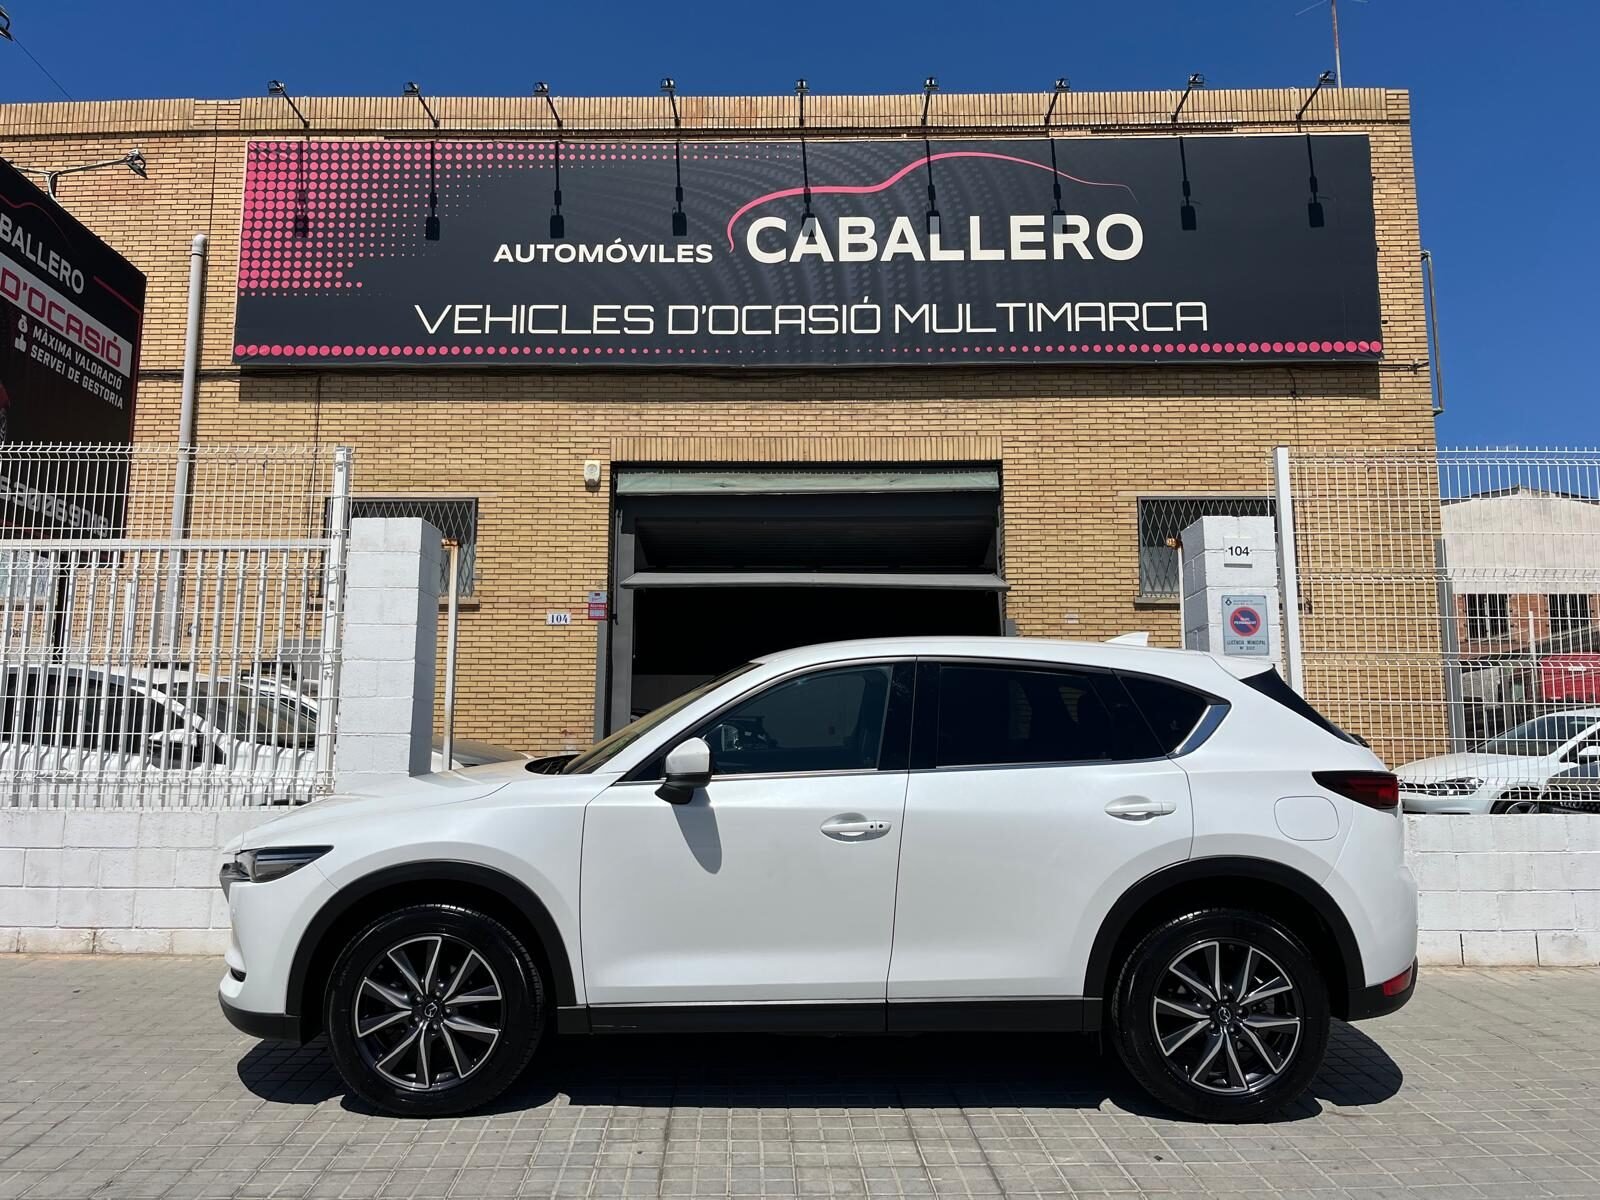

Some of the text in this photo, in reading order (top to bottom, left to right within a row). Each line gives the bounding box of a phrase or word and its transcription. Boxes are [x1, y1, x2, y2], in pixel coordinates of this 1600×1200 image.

[493, 213, 1144, 264] AUTOMÓVILES CABALLERO
[0, 267, 121, 368] D'OCASIÓ
[414, 296, 1208, 335] VEHICLES D'OCASIÓ MULTIMARCA
[30, 344, 124, 409] SERVEI DE GESTORIA
[32, 325, 123, 390] MÀXIMA VALORACIÓ
[1228, 546, 1250, 557] 104
[551, 614, 568, 624] 104
